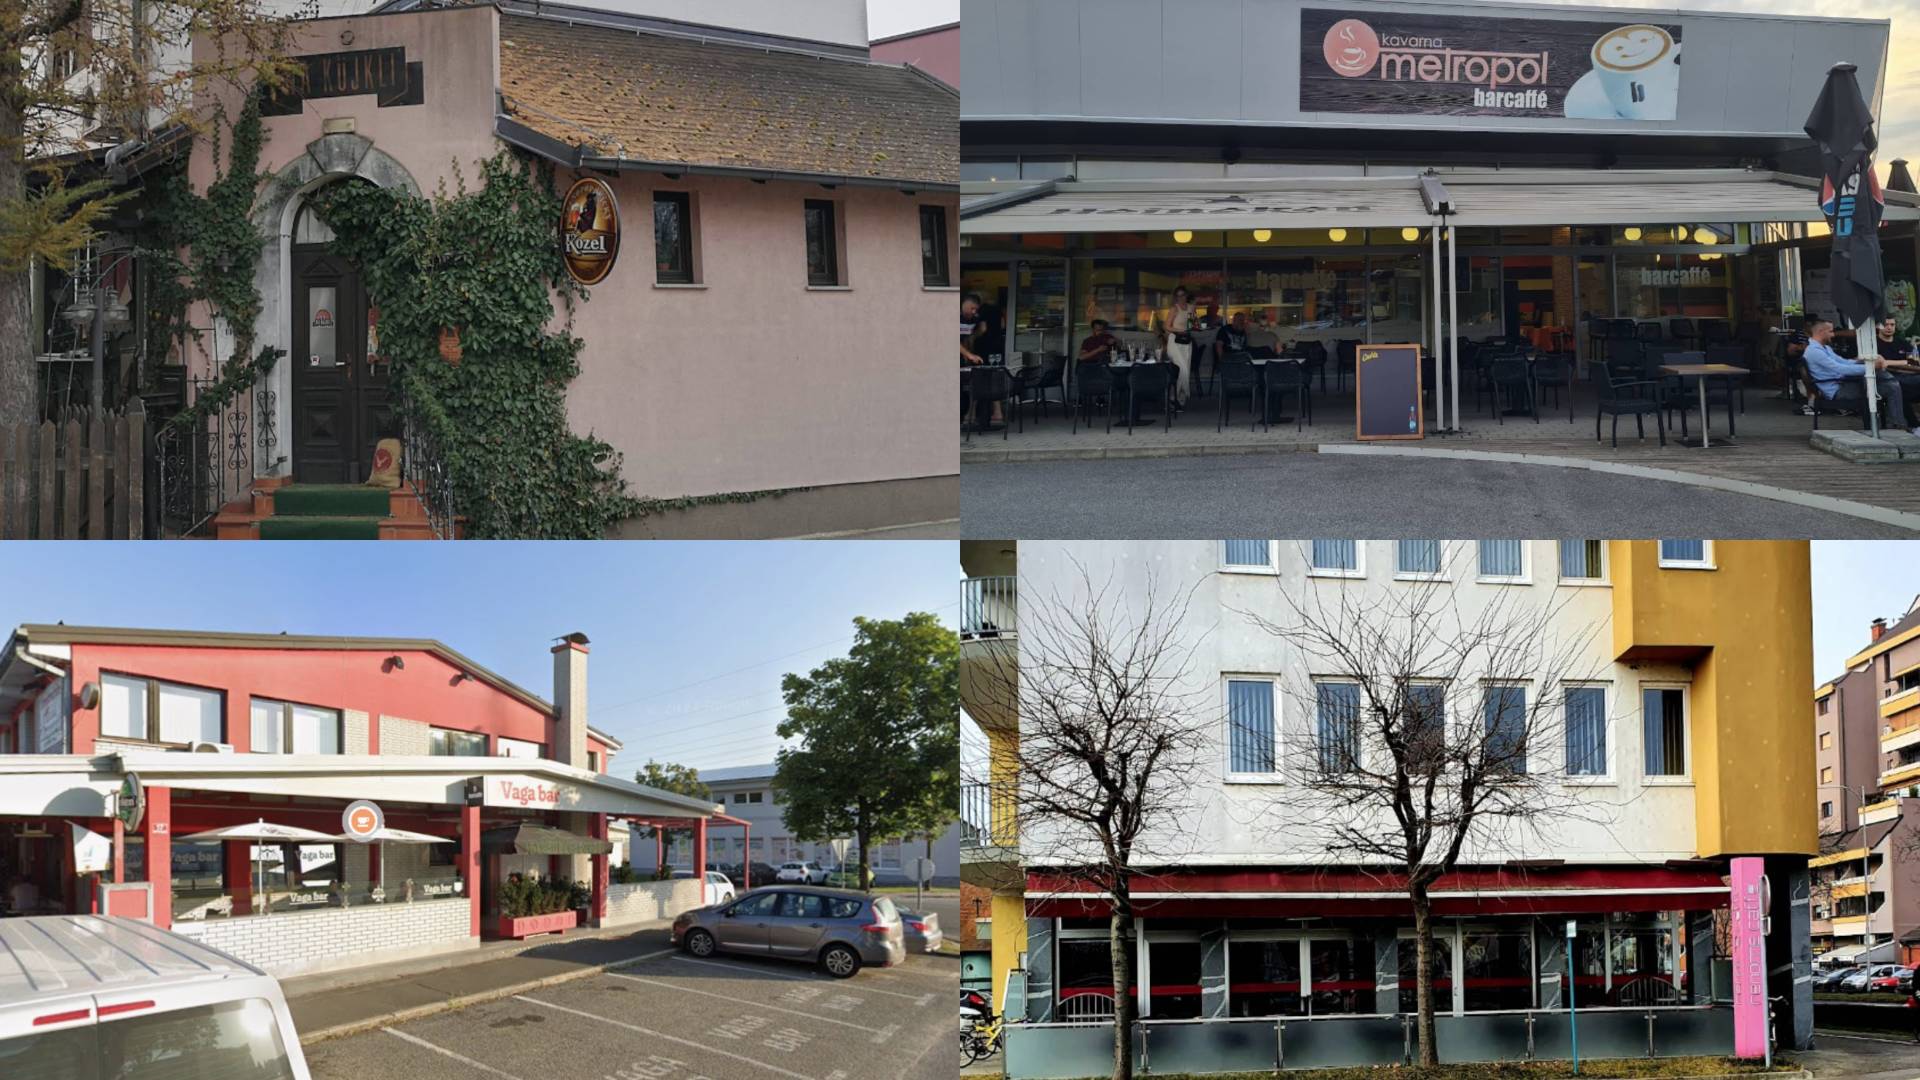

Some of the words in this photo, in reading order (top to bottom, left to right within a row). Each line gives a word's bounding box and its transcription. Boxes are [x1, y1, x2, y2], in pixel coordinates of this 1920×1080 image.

[1381, 33, 1442, 48] kavarna
[1380, 47, 1548, 89] metropol
[1473, 88, 1547, 109] barcaffé
[565, 233, 608, 254] Kozel
[500, 781, 536, 805] Vaga
[538, 784, 560, 802] bar
[319, 850, 333, 860] bar
